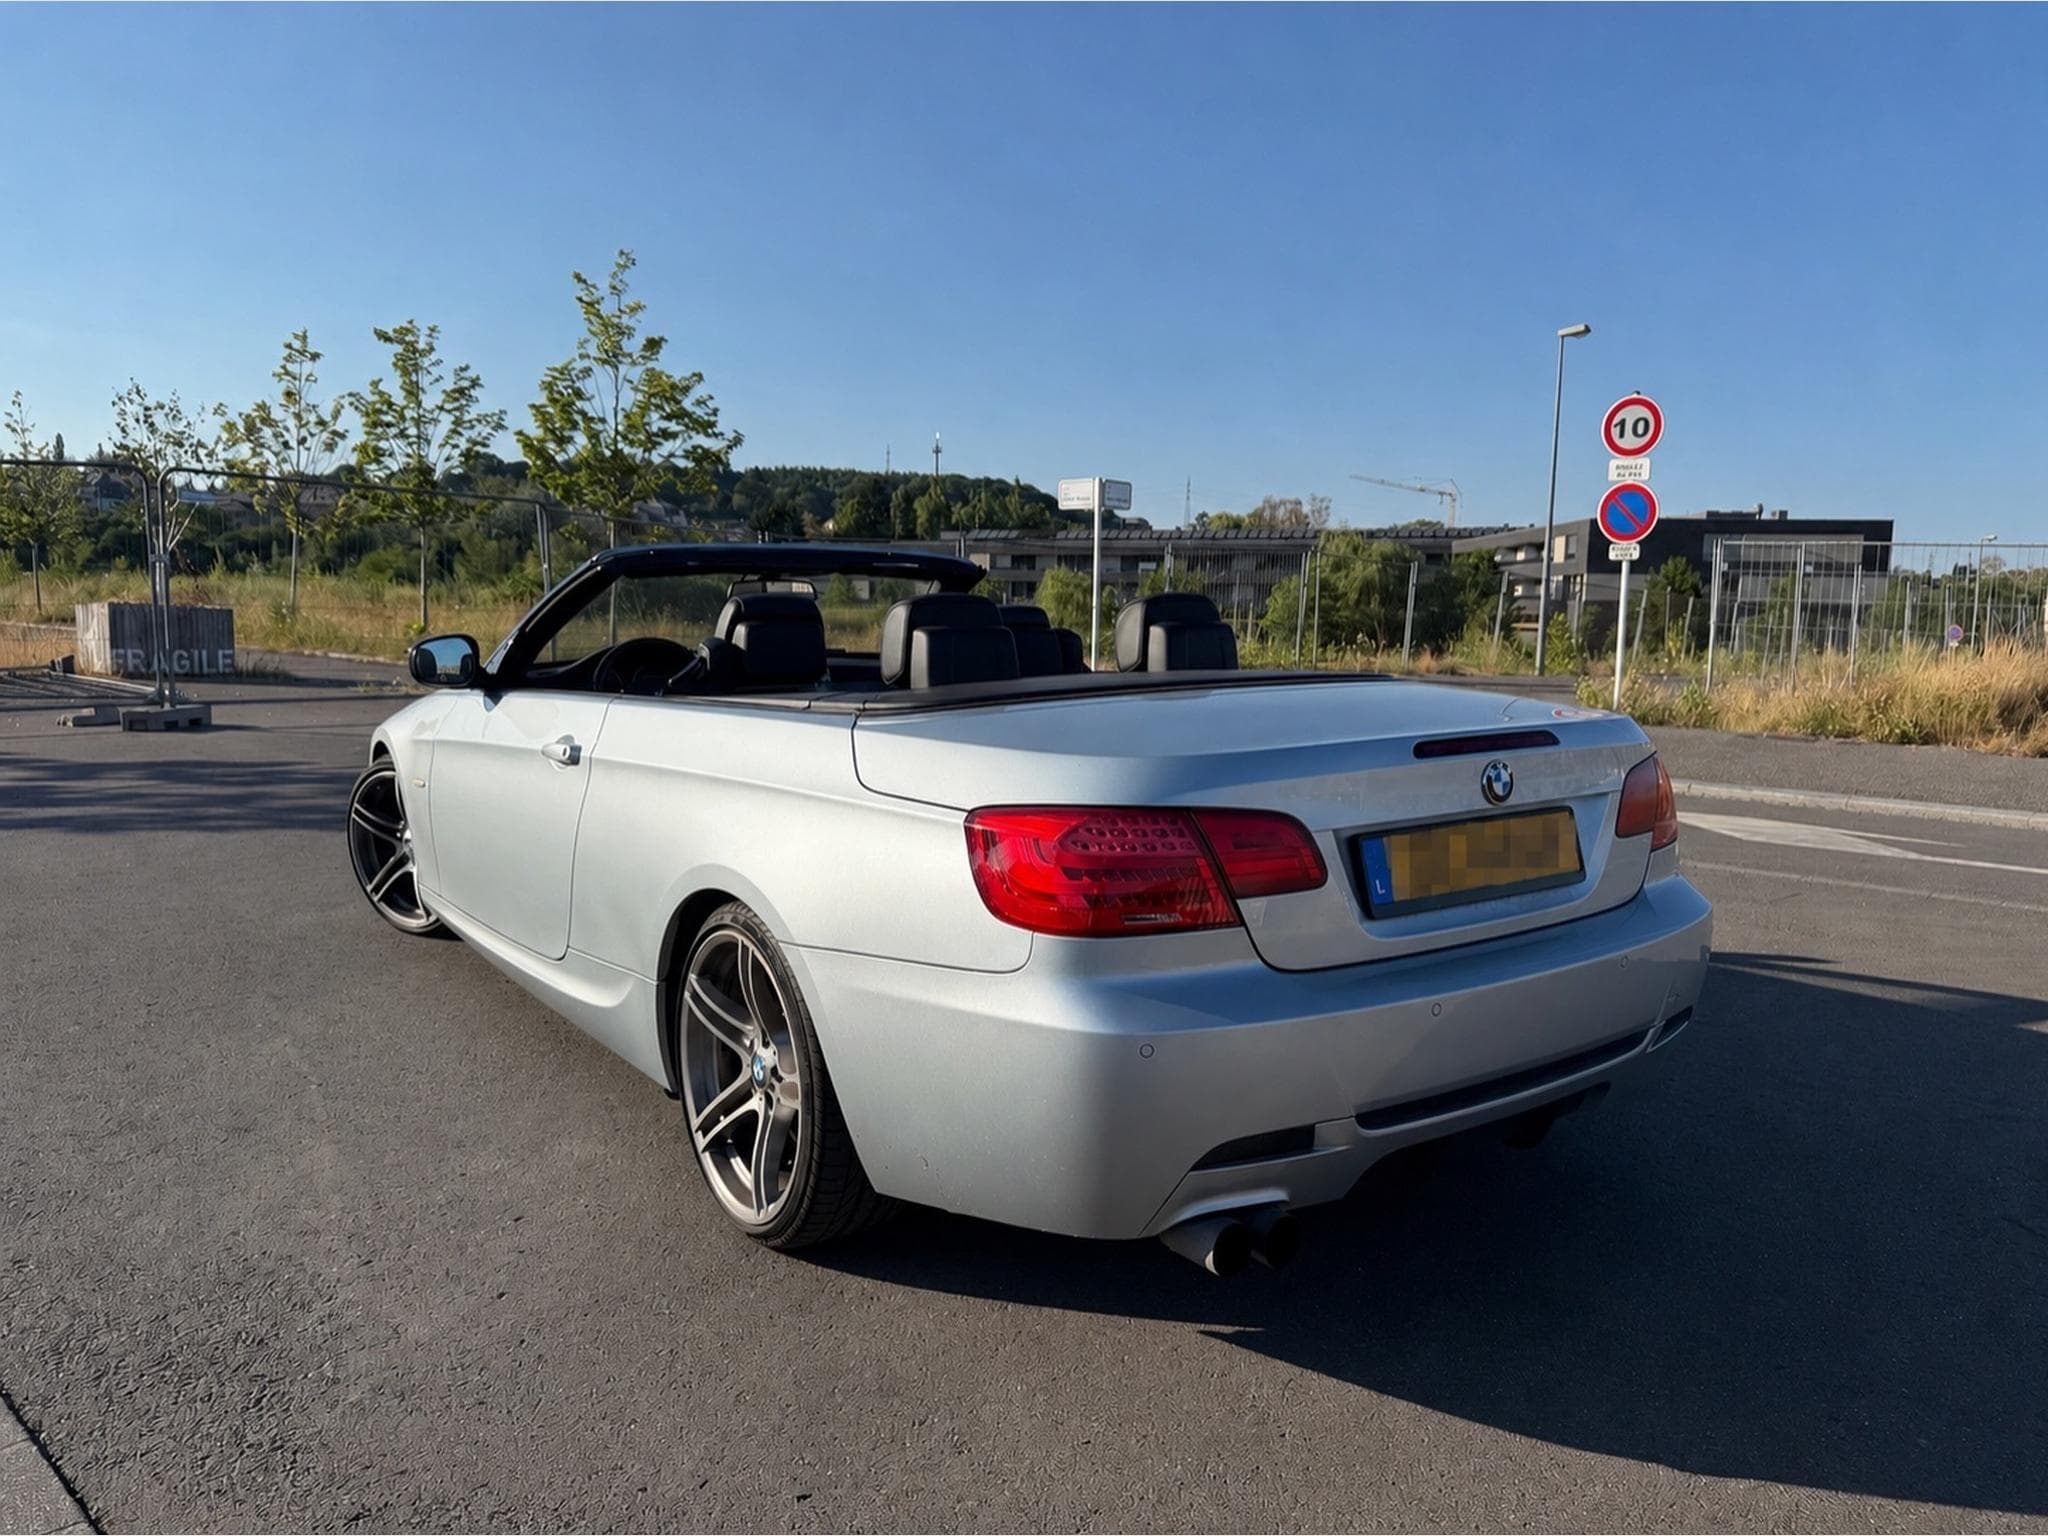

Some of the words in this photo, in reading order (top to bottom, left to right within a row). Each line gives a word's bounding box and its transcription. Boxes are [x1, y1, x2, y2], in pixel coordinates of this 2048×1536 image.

[1613, 416, 1650, 440] 10
[111, 648, 234, 673] FRAGILE
[1375, 879, 1386, 895] L
